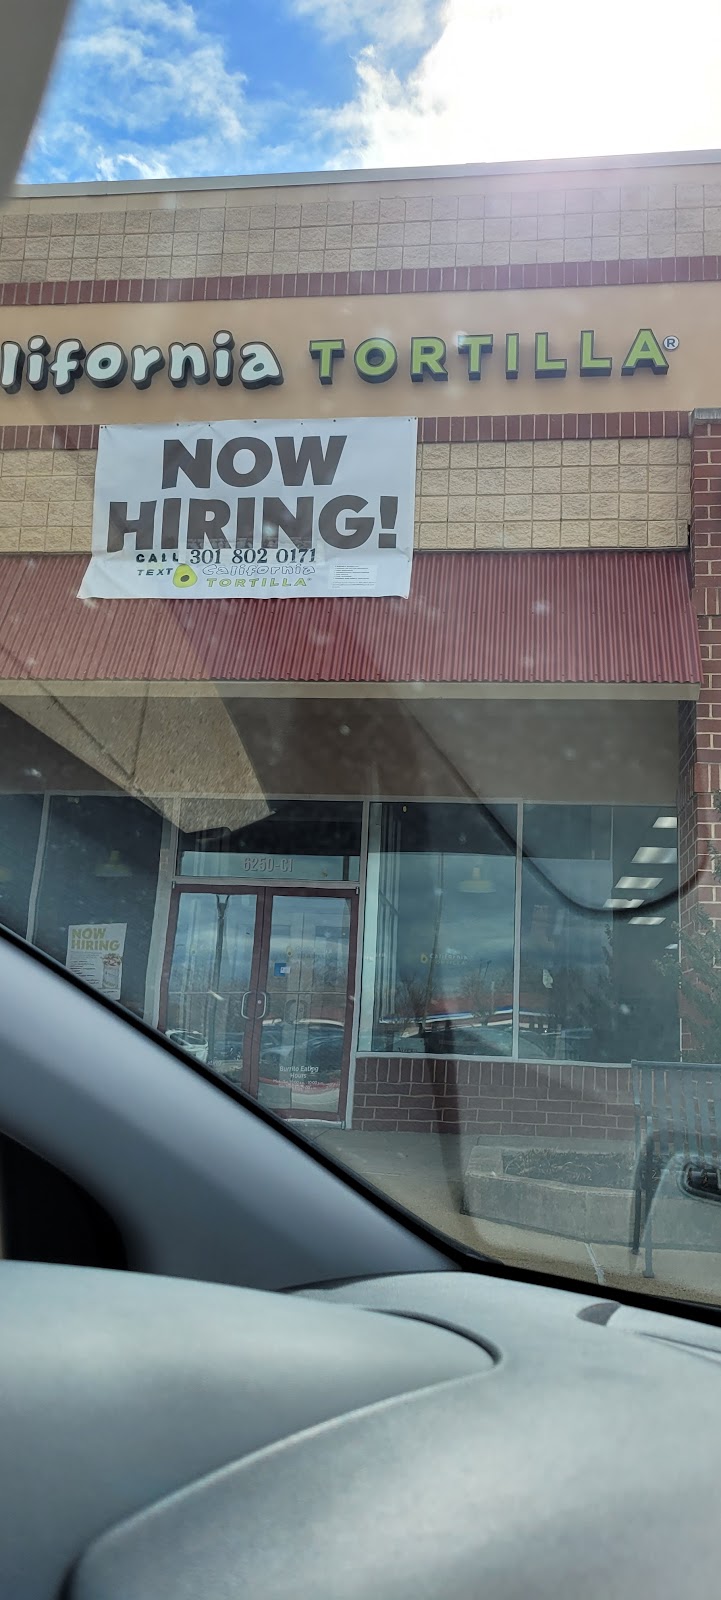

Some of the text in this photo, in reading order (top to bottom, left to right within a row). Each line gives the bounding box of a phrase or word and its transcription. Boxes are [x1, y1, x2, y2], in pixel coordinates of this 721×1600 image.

[161, 435, 347, 489] NOW
[107, 494, 399, 553] HIRING!
[135, 548, 316, 565] CALL 301 802 0171
[137, 568, 174, 576] TEXT
[202, 564, 316, 576] California
[206, 577, 312, 588] TORTILLA
[72, 928, 106, 939] NOW
[71, 940, 120, 951] HIRING
[300, 1065, 319, 1073] Eating
